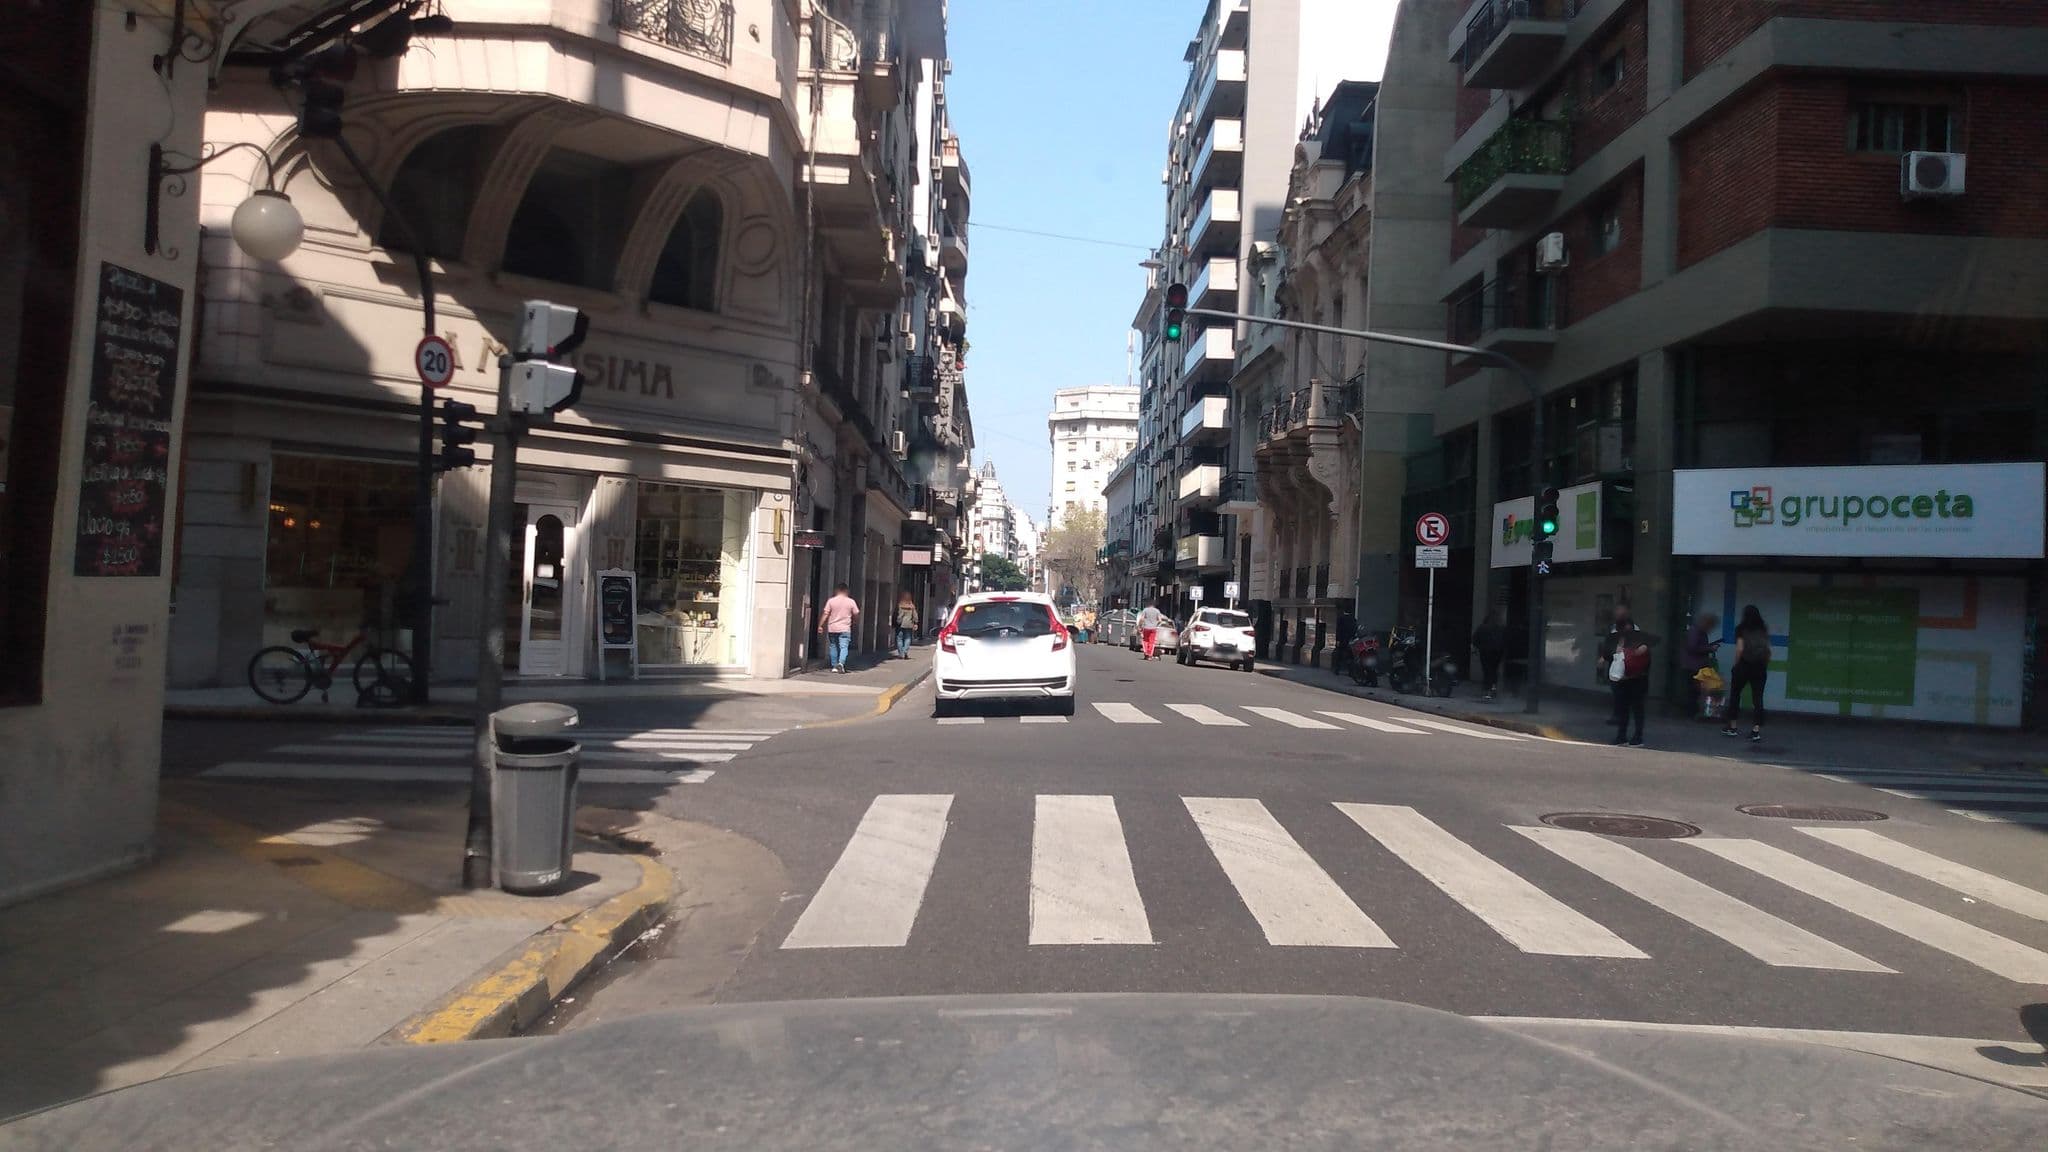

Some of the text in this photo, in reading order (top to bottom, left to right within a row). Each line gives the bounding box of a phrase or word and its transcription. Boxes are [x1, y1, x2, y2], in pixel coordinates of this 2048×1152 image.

[424, 350, 447, 374] 20
[1780, 490, 1974, 527] grupoceta
[1426, 520, 1440, 538] E
